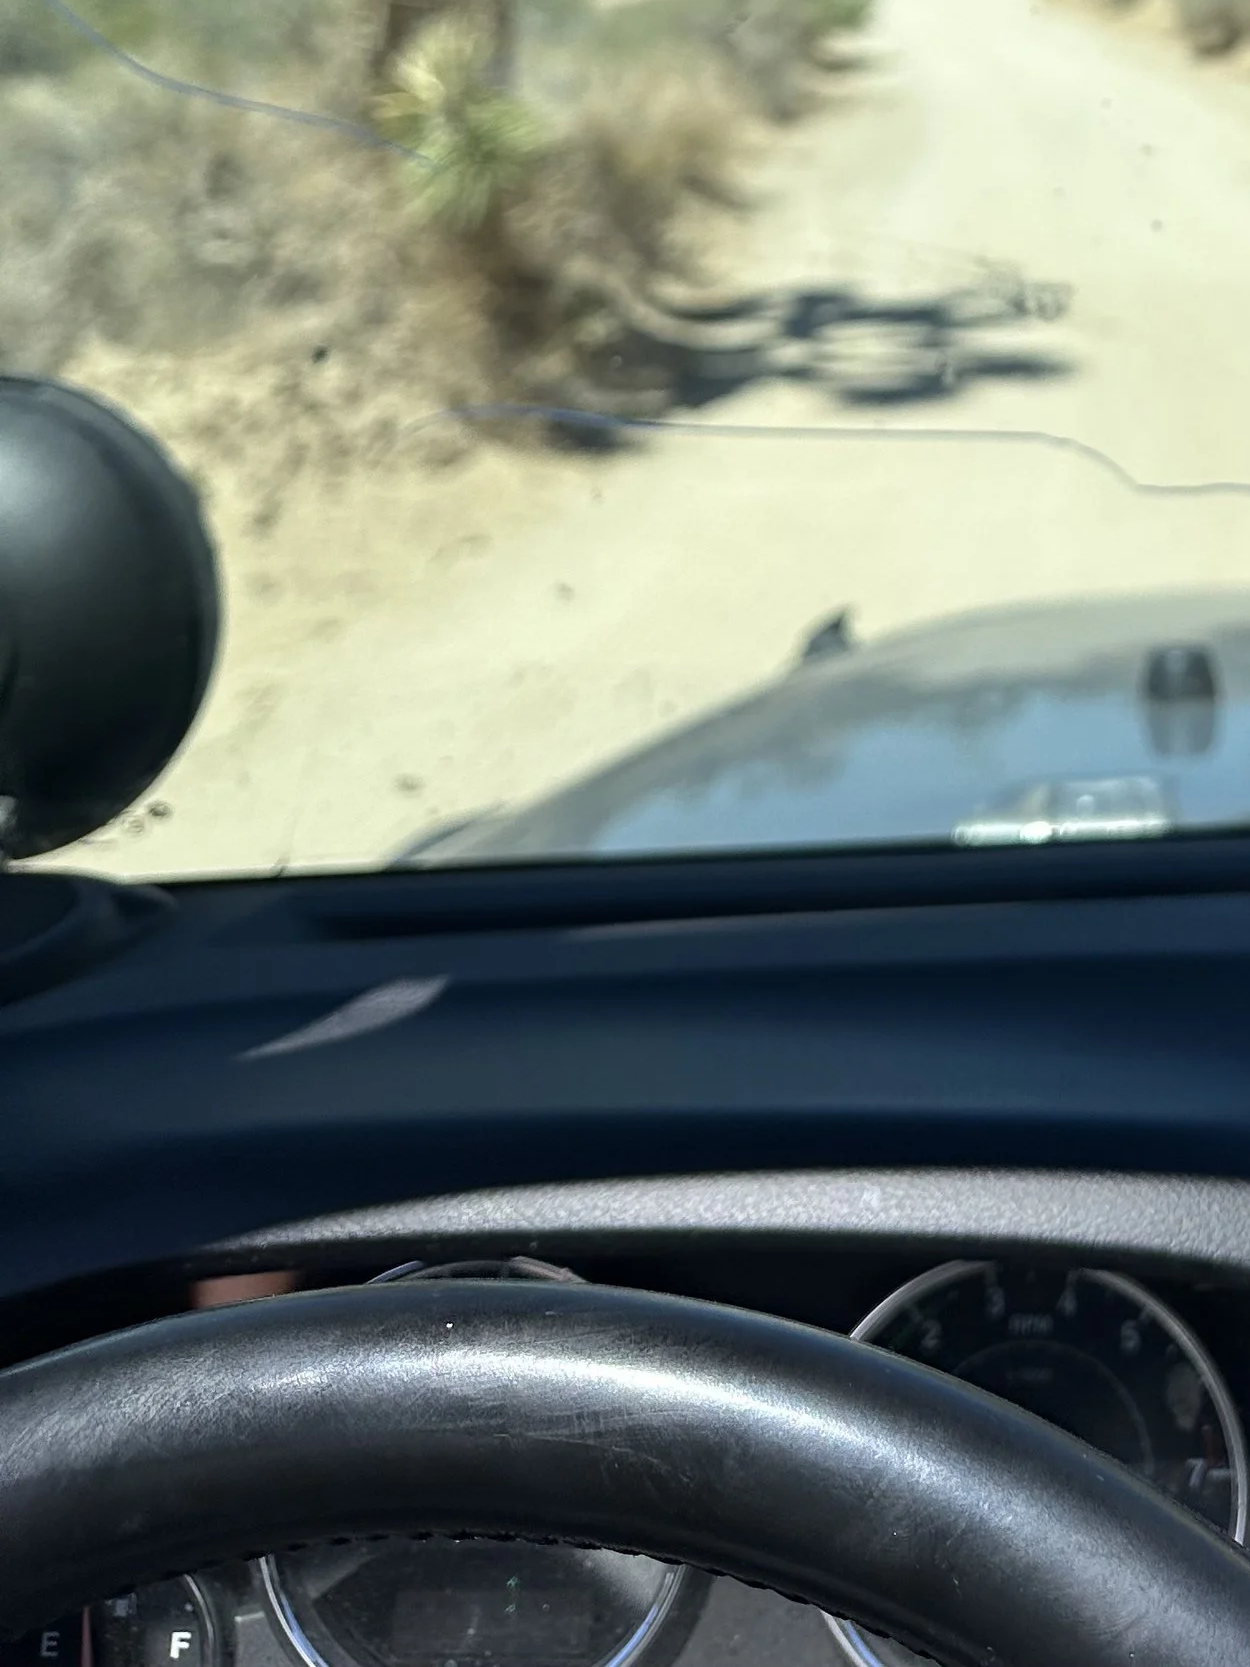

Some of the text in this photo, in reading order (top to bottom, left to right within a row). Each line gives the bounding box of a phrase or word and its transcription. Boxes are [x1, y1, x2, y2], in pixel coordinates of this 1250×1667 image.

[1186, 1458, 1205, 1488] 7
[39, 1630, 60, 1658] E
[169, 1630, 192, 1659] F
